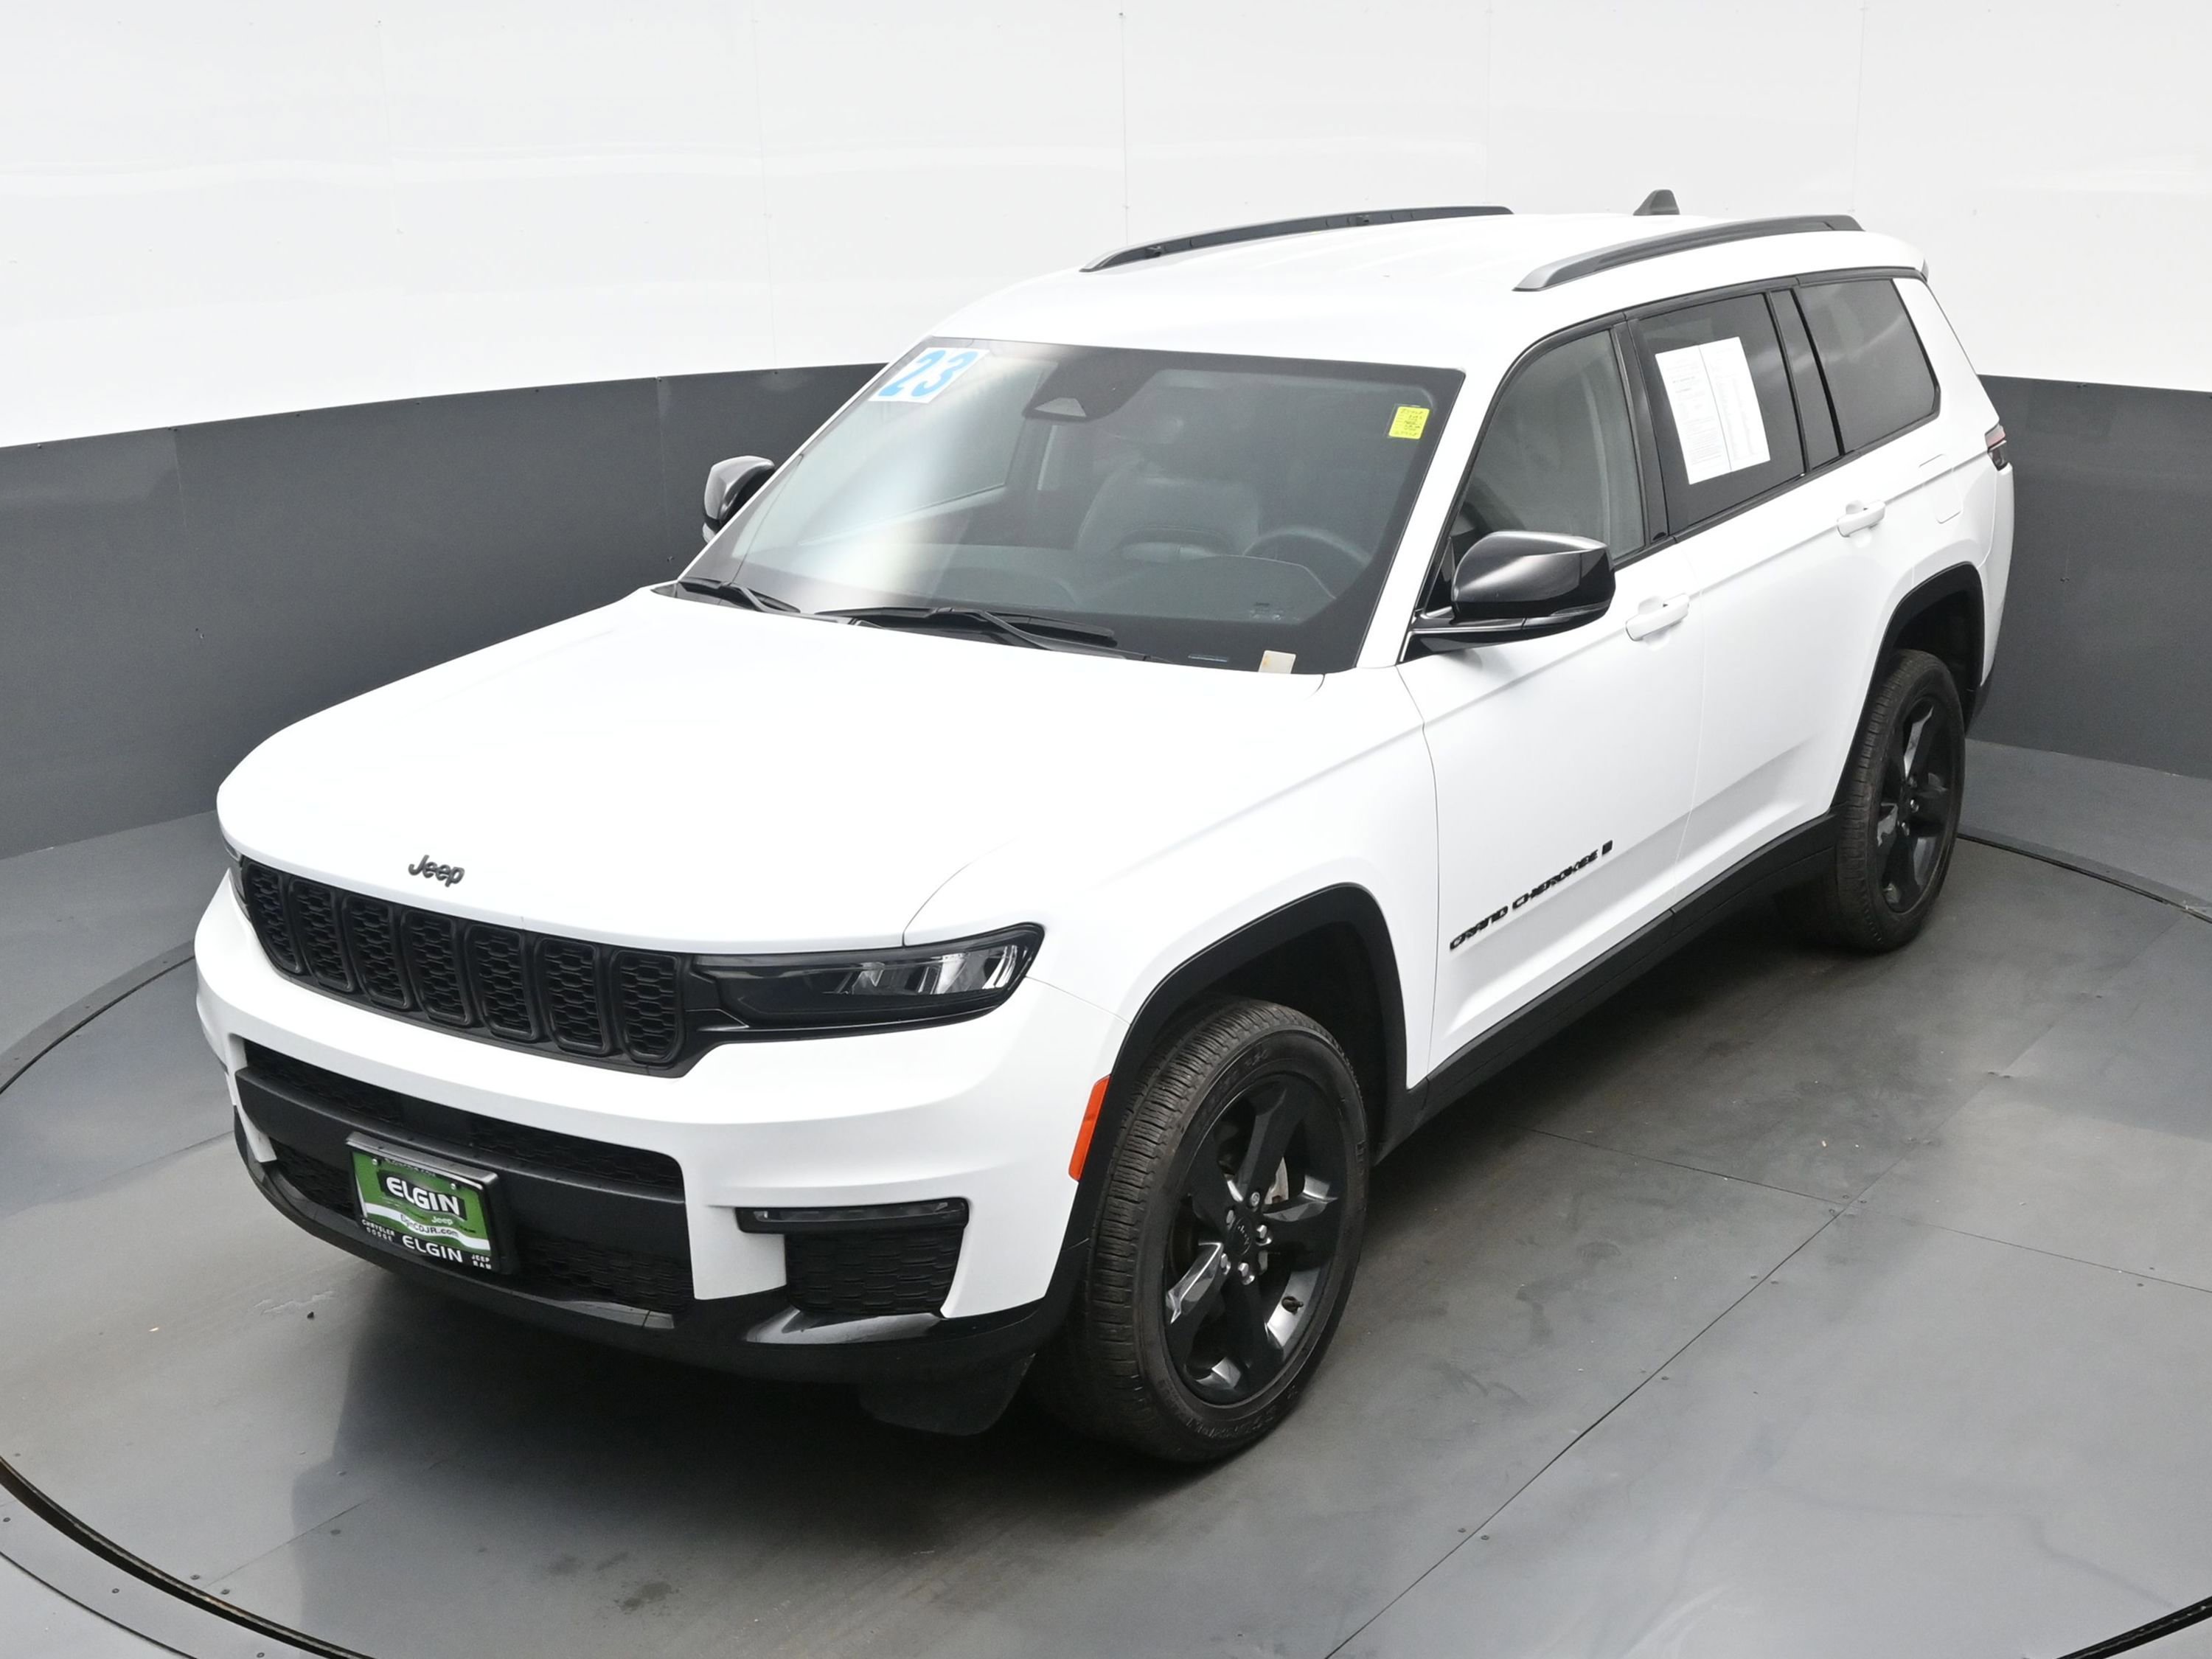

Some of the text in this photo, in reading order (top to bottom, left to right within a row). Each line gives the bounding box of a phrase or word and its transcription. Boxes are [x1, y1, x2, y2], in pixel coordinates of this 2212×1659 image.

[878, 349, 979, 397] 23
[408, 855, 465, 888] Jeep
[1449, 849, 1599, 950] GRAND CHEROKEE
[386, 1176, 461, 1216] ELGIN
[431, 1216, 453, 1225] Jeep
[402, 1235, 463, 1263] ELGIN
